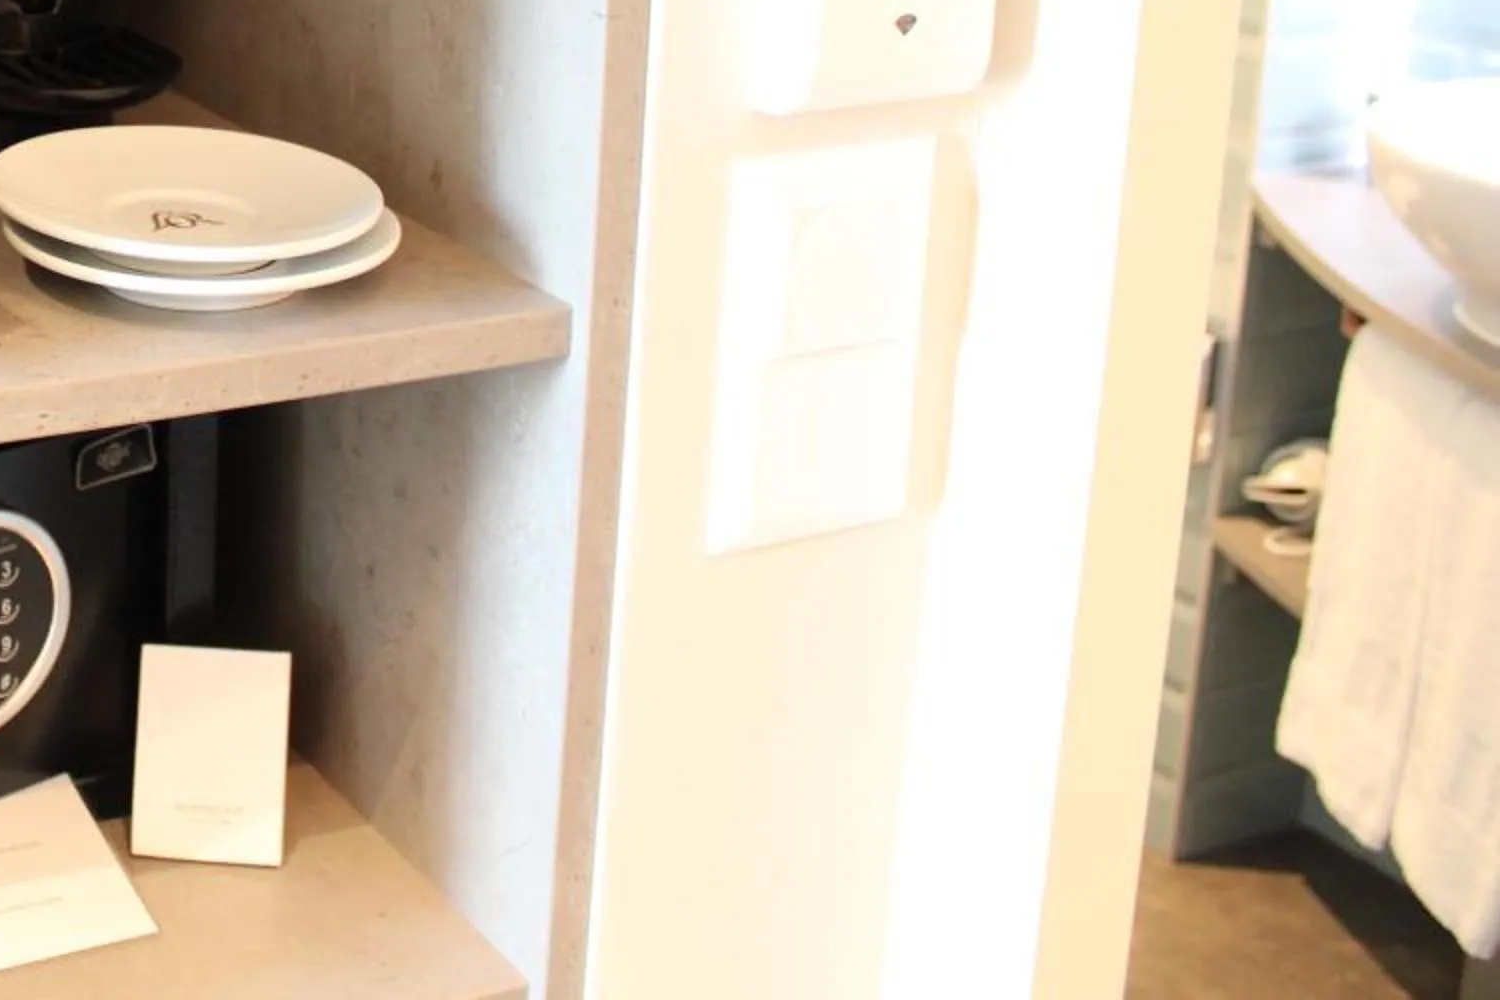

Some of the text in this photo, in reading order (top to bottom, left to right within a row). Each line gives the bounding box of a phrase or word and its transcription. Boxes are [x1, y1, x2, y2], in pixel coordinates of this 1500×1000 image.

[0, 560, 12, 578] 3
[0, 598, 12, 615] 6
[0, 635, 13, 653] 9
